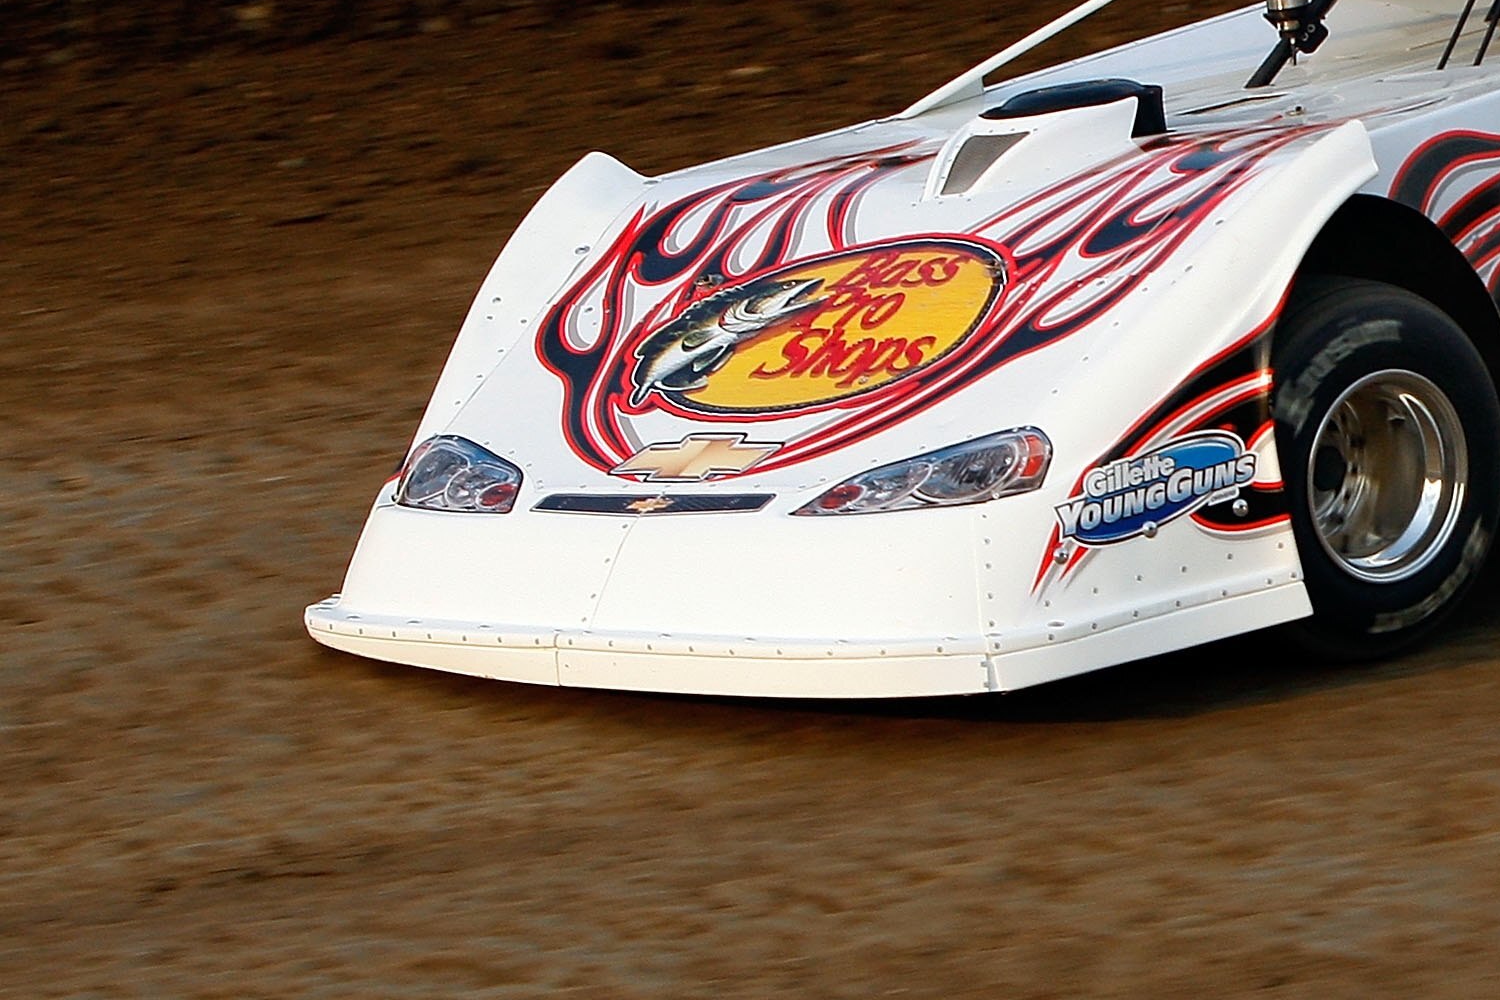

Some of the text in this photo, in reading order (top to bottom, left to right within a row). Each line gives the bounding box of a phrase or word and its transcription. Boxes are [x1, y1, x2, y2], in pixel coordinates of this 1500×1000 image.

[825, 250, 974, 292] Bass
[792, 286, 906, 333] Pro
[748, 326, 937, 389] Shops
[1085, 454, 1177, 499] Gillette
